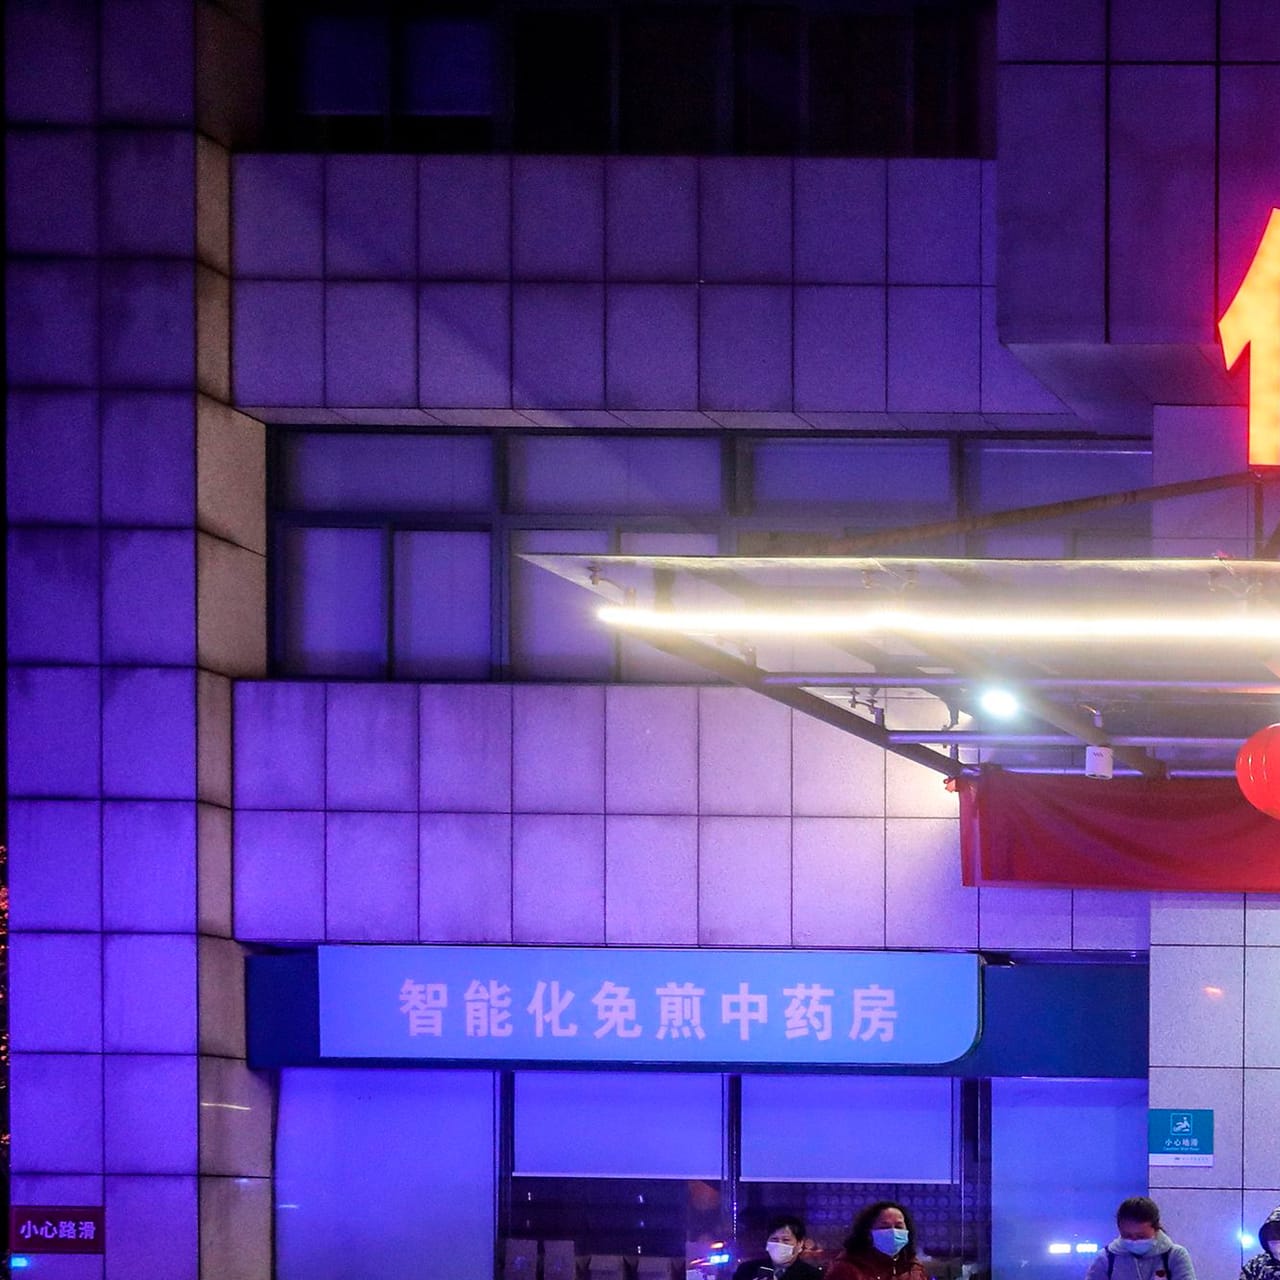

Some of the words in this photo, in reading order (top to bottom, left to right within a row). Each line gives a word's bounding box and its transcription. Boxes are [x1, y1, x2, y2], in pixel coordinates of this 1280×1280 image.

[399, 978, 898, 1043] 智能化免煎中药房
[20, 1220, 96, 1240] 小心路滑
